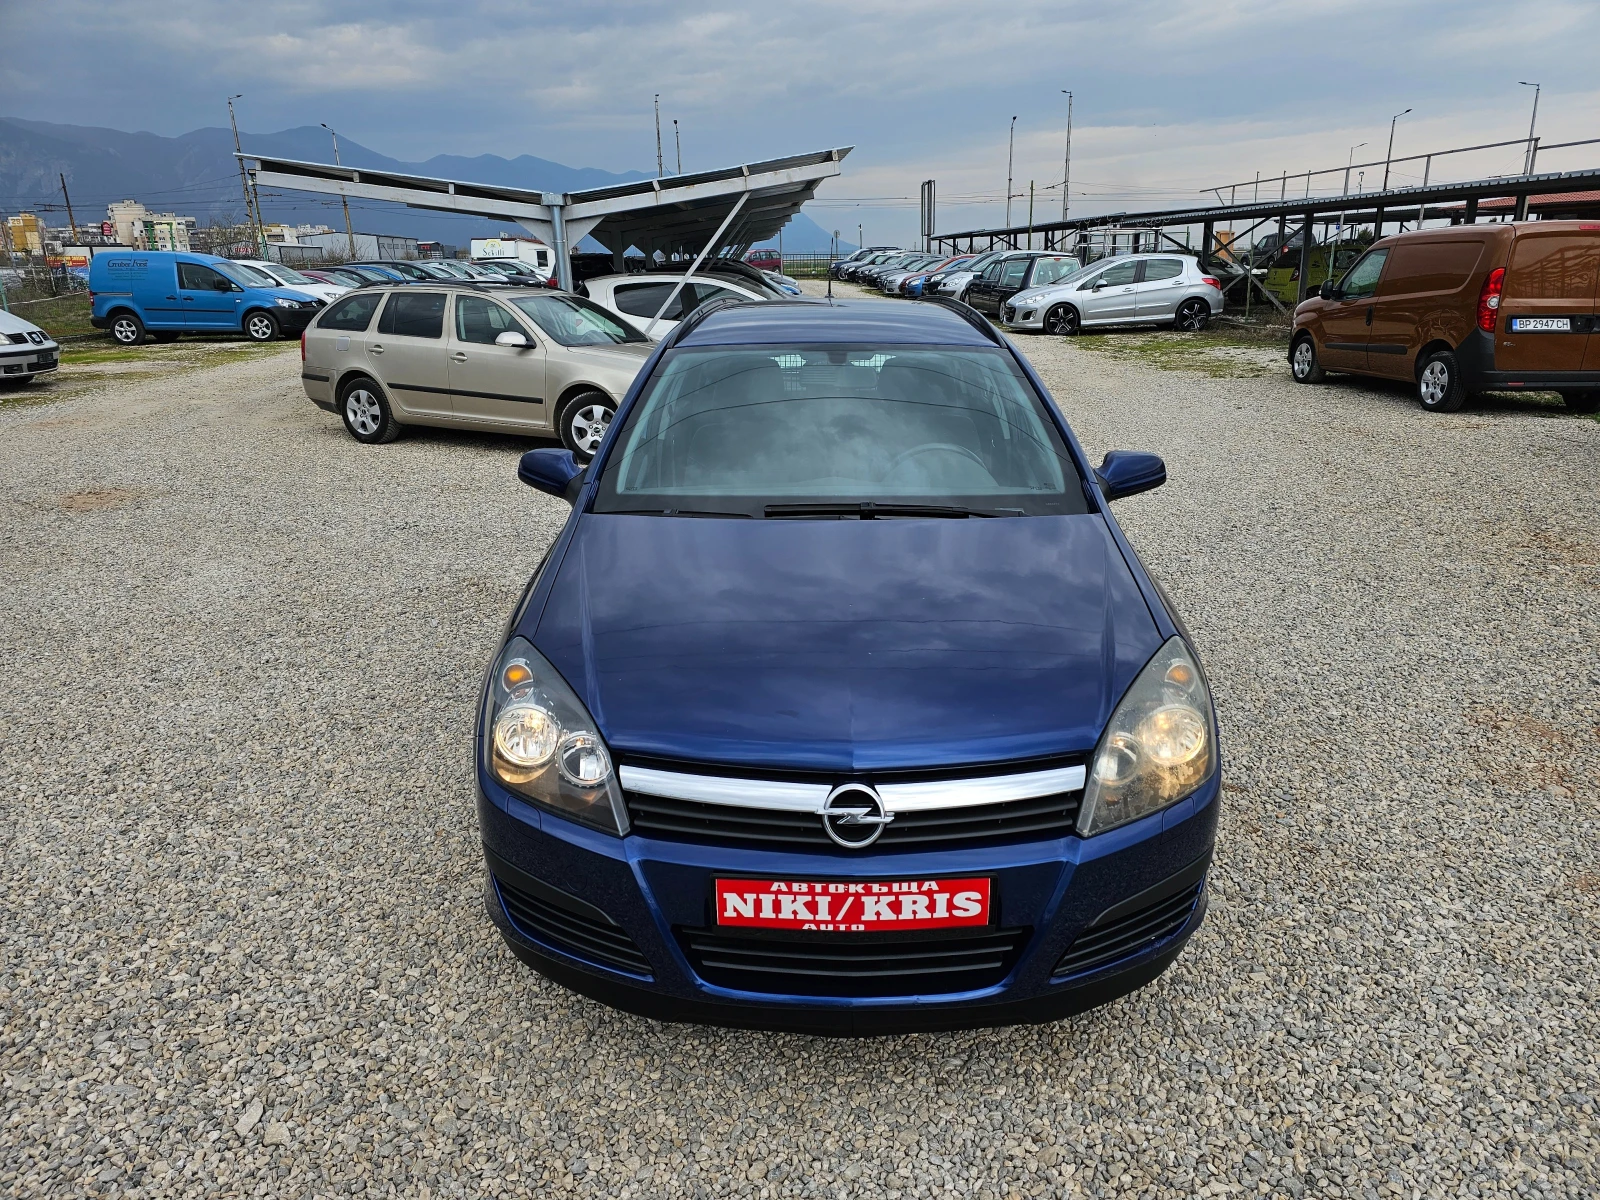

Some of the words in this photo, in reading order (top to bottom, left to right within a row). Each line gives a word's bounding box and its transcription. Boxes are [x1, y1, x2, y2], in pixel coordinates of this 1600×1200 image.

[108, 259, 131, 267] Gruber
[1519, 320, 1531, 328] BP
[1533, 320, 1554, 328] 2947
[1557, 320, 1568, 328] CH
[770, 881, 940, 893] АВТОКЪЩА
[802, 923, 865, 931] AUTO
